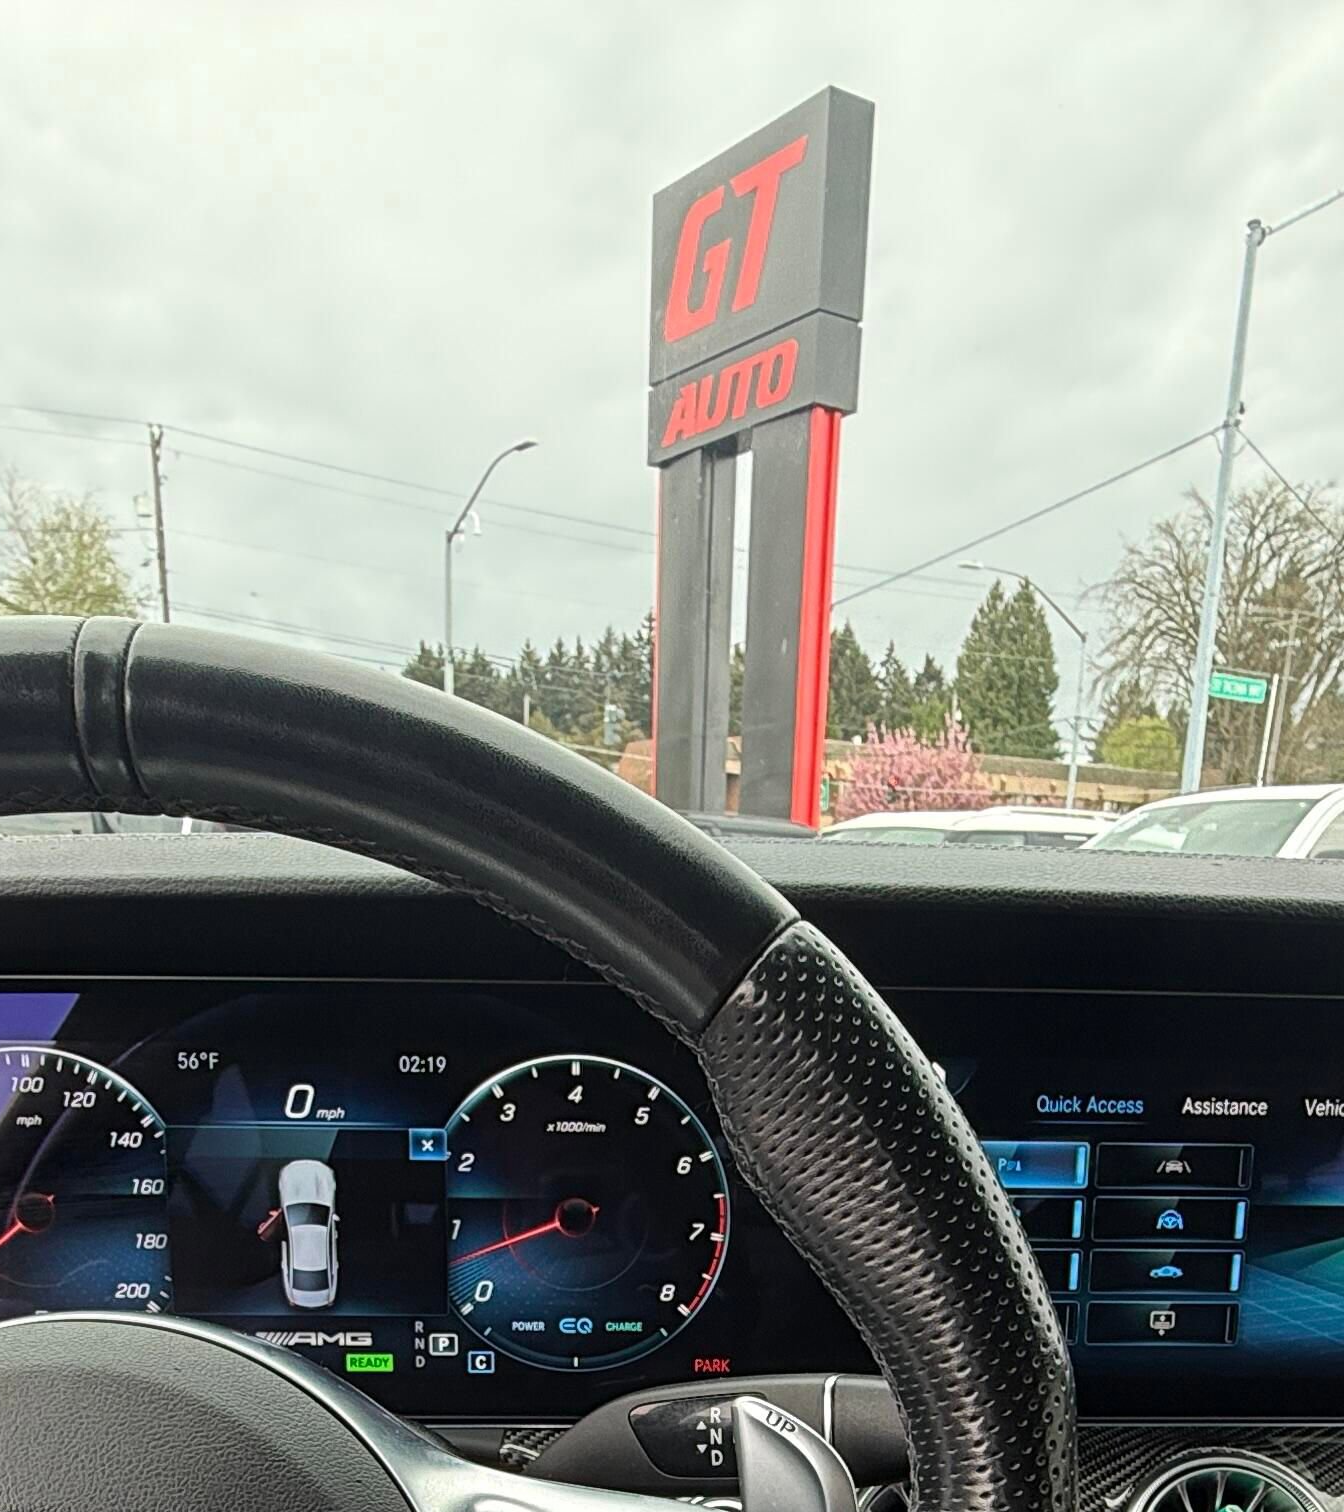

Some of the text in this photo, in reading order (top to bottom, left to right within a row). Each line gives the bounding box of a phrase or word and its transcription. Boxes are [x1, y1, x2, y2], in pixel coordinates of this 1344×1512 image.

[663, 134, 809, 343] GT
[661, 337, 798, 448] AUTO
[177, 1051, 220, 1071] 56°F
[398, 1055, 448, 1074] 02:19
[11, 1076, 45, 1093] 100
[63, 1091, 96, 1109] 120
[284, 1083, 346, 1121] 0 mph
[567, 1085, 584, 1103] 4
[499, 1103, 516, 1122] 3
[1036, 1095, 1145, 1115] Quick Access
[1181, 1097, 1268, 1117] Assistance
[16, 1113, 43, 1127] mph
[634, 1107, 651, 1125] 5
[109, 1131, 143, 1149] 140
[457, 1152, 476, 1172] 2
[676, 1156, 693, 1174] 6
[131, 1178, 165, 1196] 160
[451, 1219, 462, 1241] 1
[689, 1223, 705, 1242] 7
[135, 1232, 168, 1250] 180
[115, 1283, 150, 1300] 200
[474, 1280, 494, 1302] 0
[659, 1284, 676, 1302] 8
[414, 1320, 424, 1334] R
[511, 1321, 546, 1333] POWER
[605, 1320, 643, 1333] CHARGE
[414, 1337, 425, 1350] N
[437, 1337, 450, 1352] P
[349, 1355, 390, 1369] READY
[415, 1355, 426, 1368] D
[475, 1354, 487, 1370] C
[693, 1359, 731, 1373] PARK
[709, 1407, 721, 1423] R
[765, 1410, 798, 1434] UP
[709, 1428, 723, 1445] N
[711, 1450, 723, 1466] D
